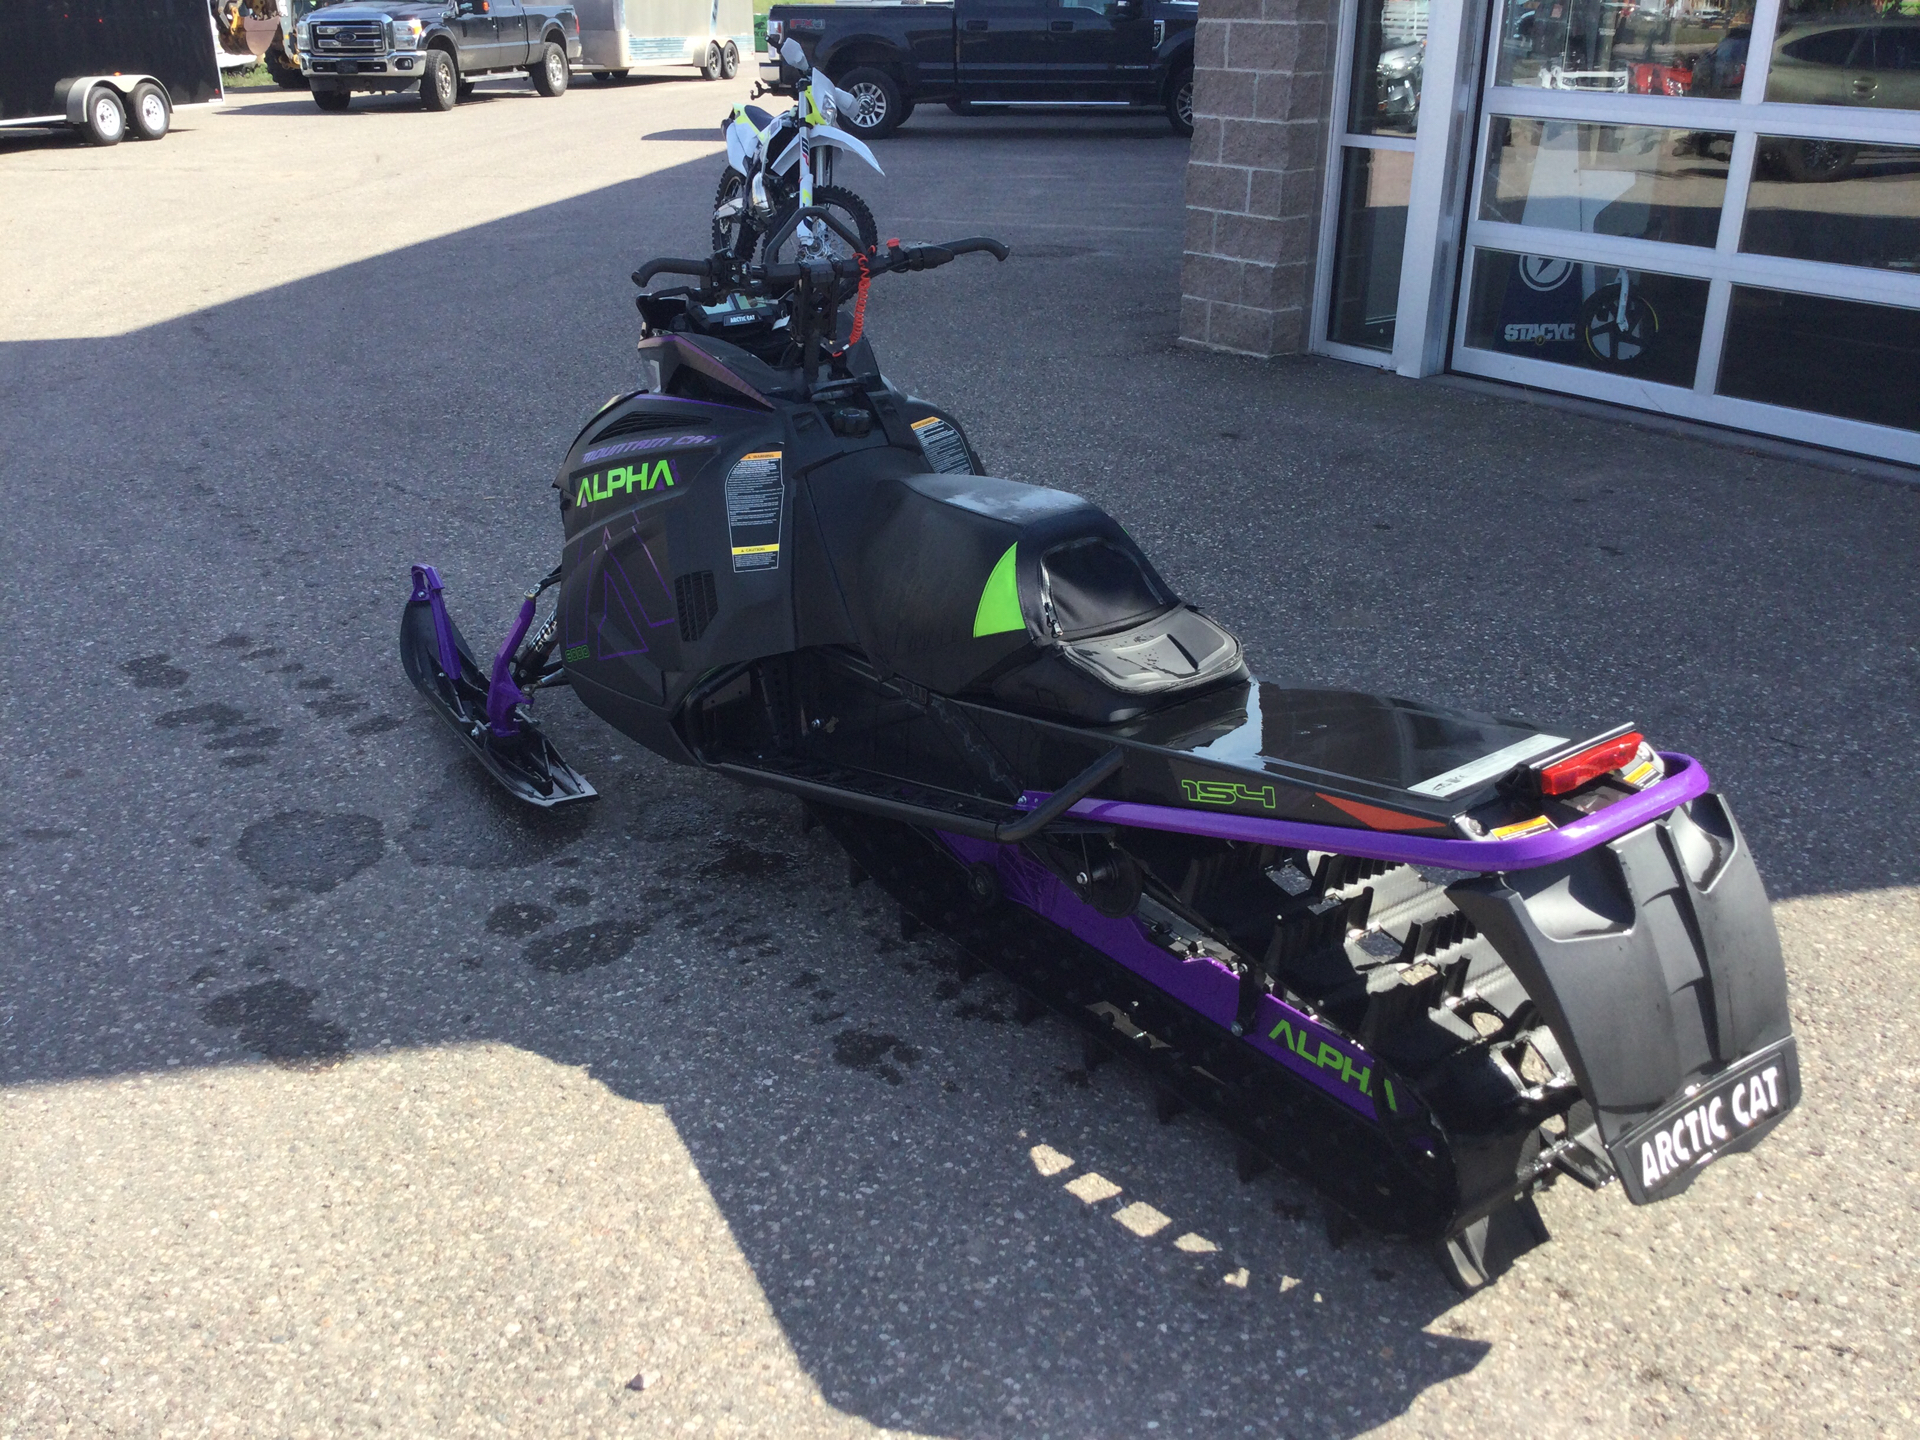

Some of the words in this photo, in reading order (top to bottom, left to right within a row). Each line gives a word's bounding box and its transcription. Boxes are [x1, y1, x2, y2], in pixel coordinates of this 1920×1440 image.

[730, 316, 747, 324] ARCTIC
[1504, 323, 1576, 341] STACYC
[582, 437, 673, 464] MOUNTAIN
[673, 434, 723, 446] CAT
[576, 459, 675, 508] ALPHA
[1181, 779, 1276, 809] 154
[1640, 1095, 1729, 1188] ARCTIC
[1732, 1066, 1779, 1127] CAT
